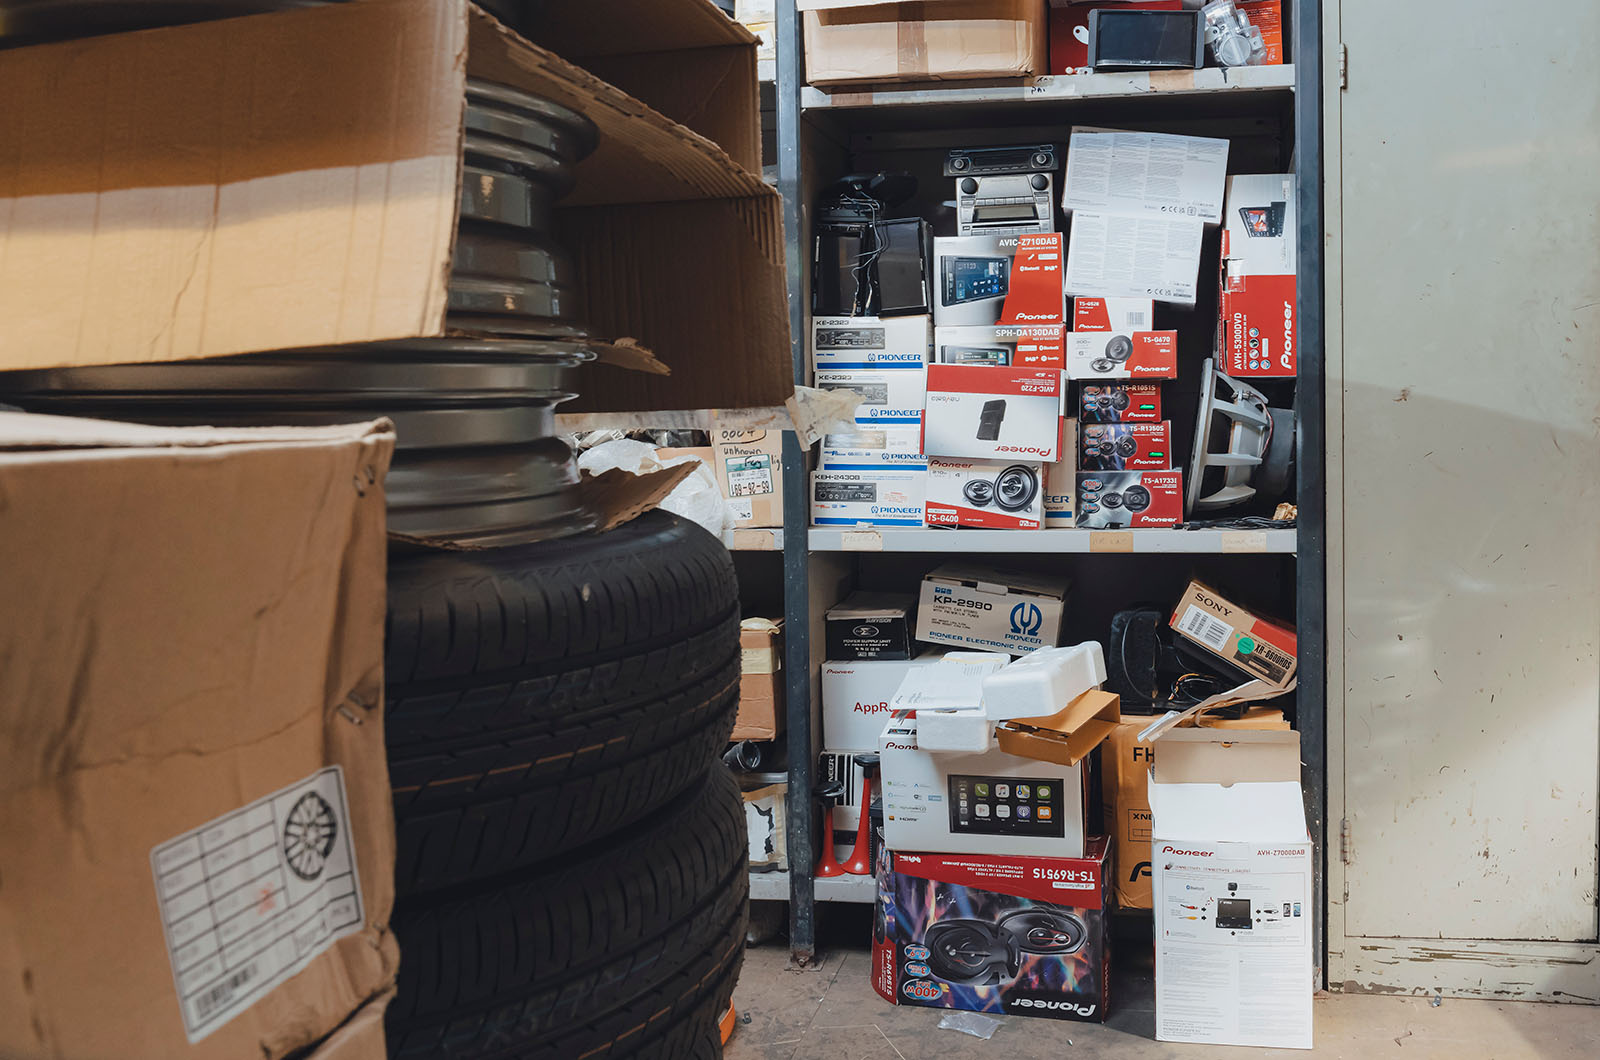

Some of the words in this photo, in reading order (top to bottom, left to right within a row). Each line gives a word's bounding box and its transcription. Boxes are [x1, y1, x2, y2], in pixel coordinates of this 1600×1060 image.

[999, 237, 1058, 247] AVIC-Z710DAB
[1016, 312, 1059, 321] Pioneer
[995, 328, 1060, 337] SPH-DA130DAB
[1281, 300, 1292, 370] Pioneer
[1233, 312, 1242, 370] AVH-5300DVD
[880, 409, 923, 417] PIONEER
[995, 446, 1051, 457] Pioneer
[930, 459, 974, 469] Pioneer
[880, 506, 921, 514] PIONEER
[927, 513, 959, 523] TS-G400
[933, 595, 993, 611] KP-2980
[1194, 592, 1233, 617] SONY
[929, 631, 963, 641] PIONEER
[966, 637, 1015, 650] ELECTRONIC
[1004, 633, 1042, 645] PIONEER
[854, 701, 892, 715] AppR
[1162, 845, 1215, 857] Pioneer
[1033, 867, 1095, 882] TS-R6951S
[906, 985, 939, 998] 400W
[1011, 998, 1097, 1017] Pioneer
